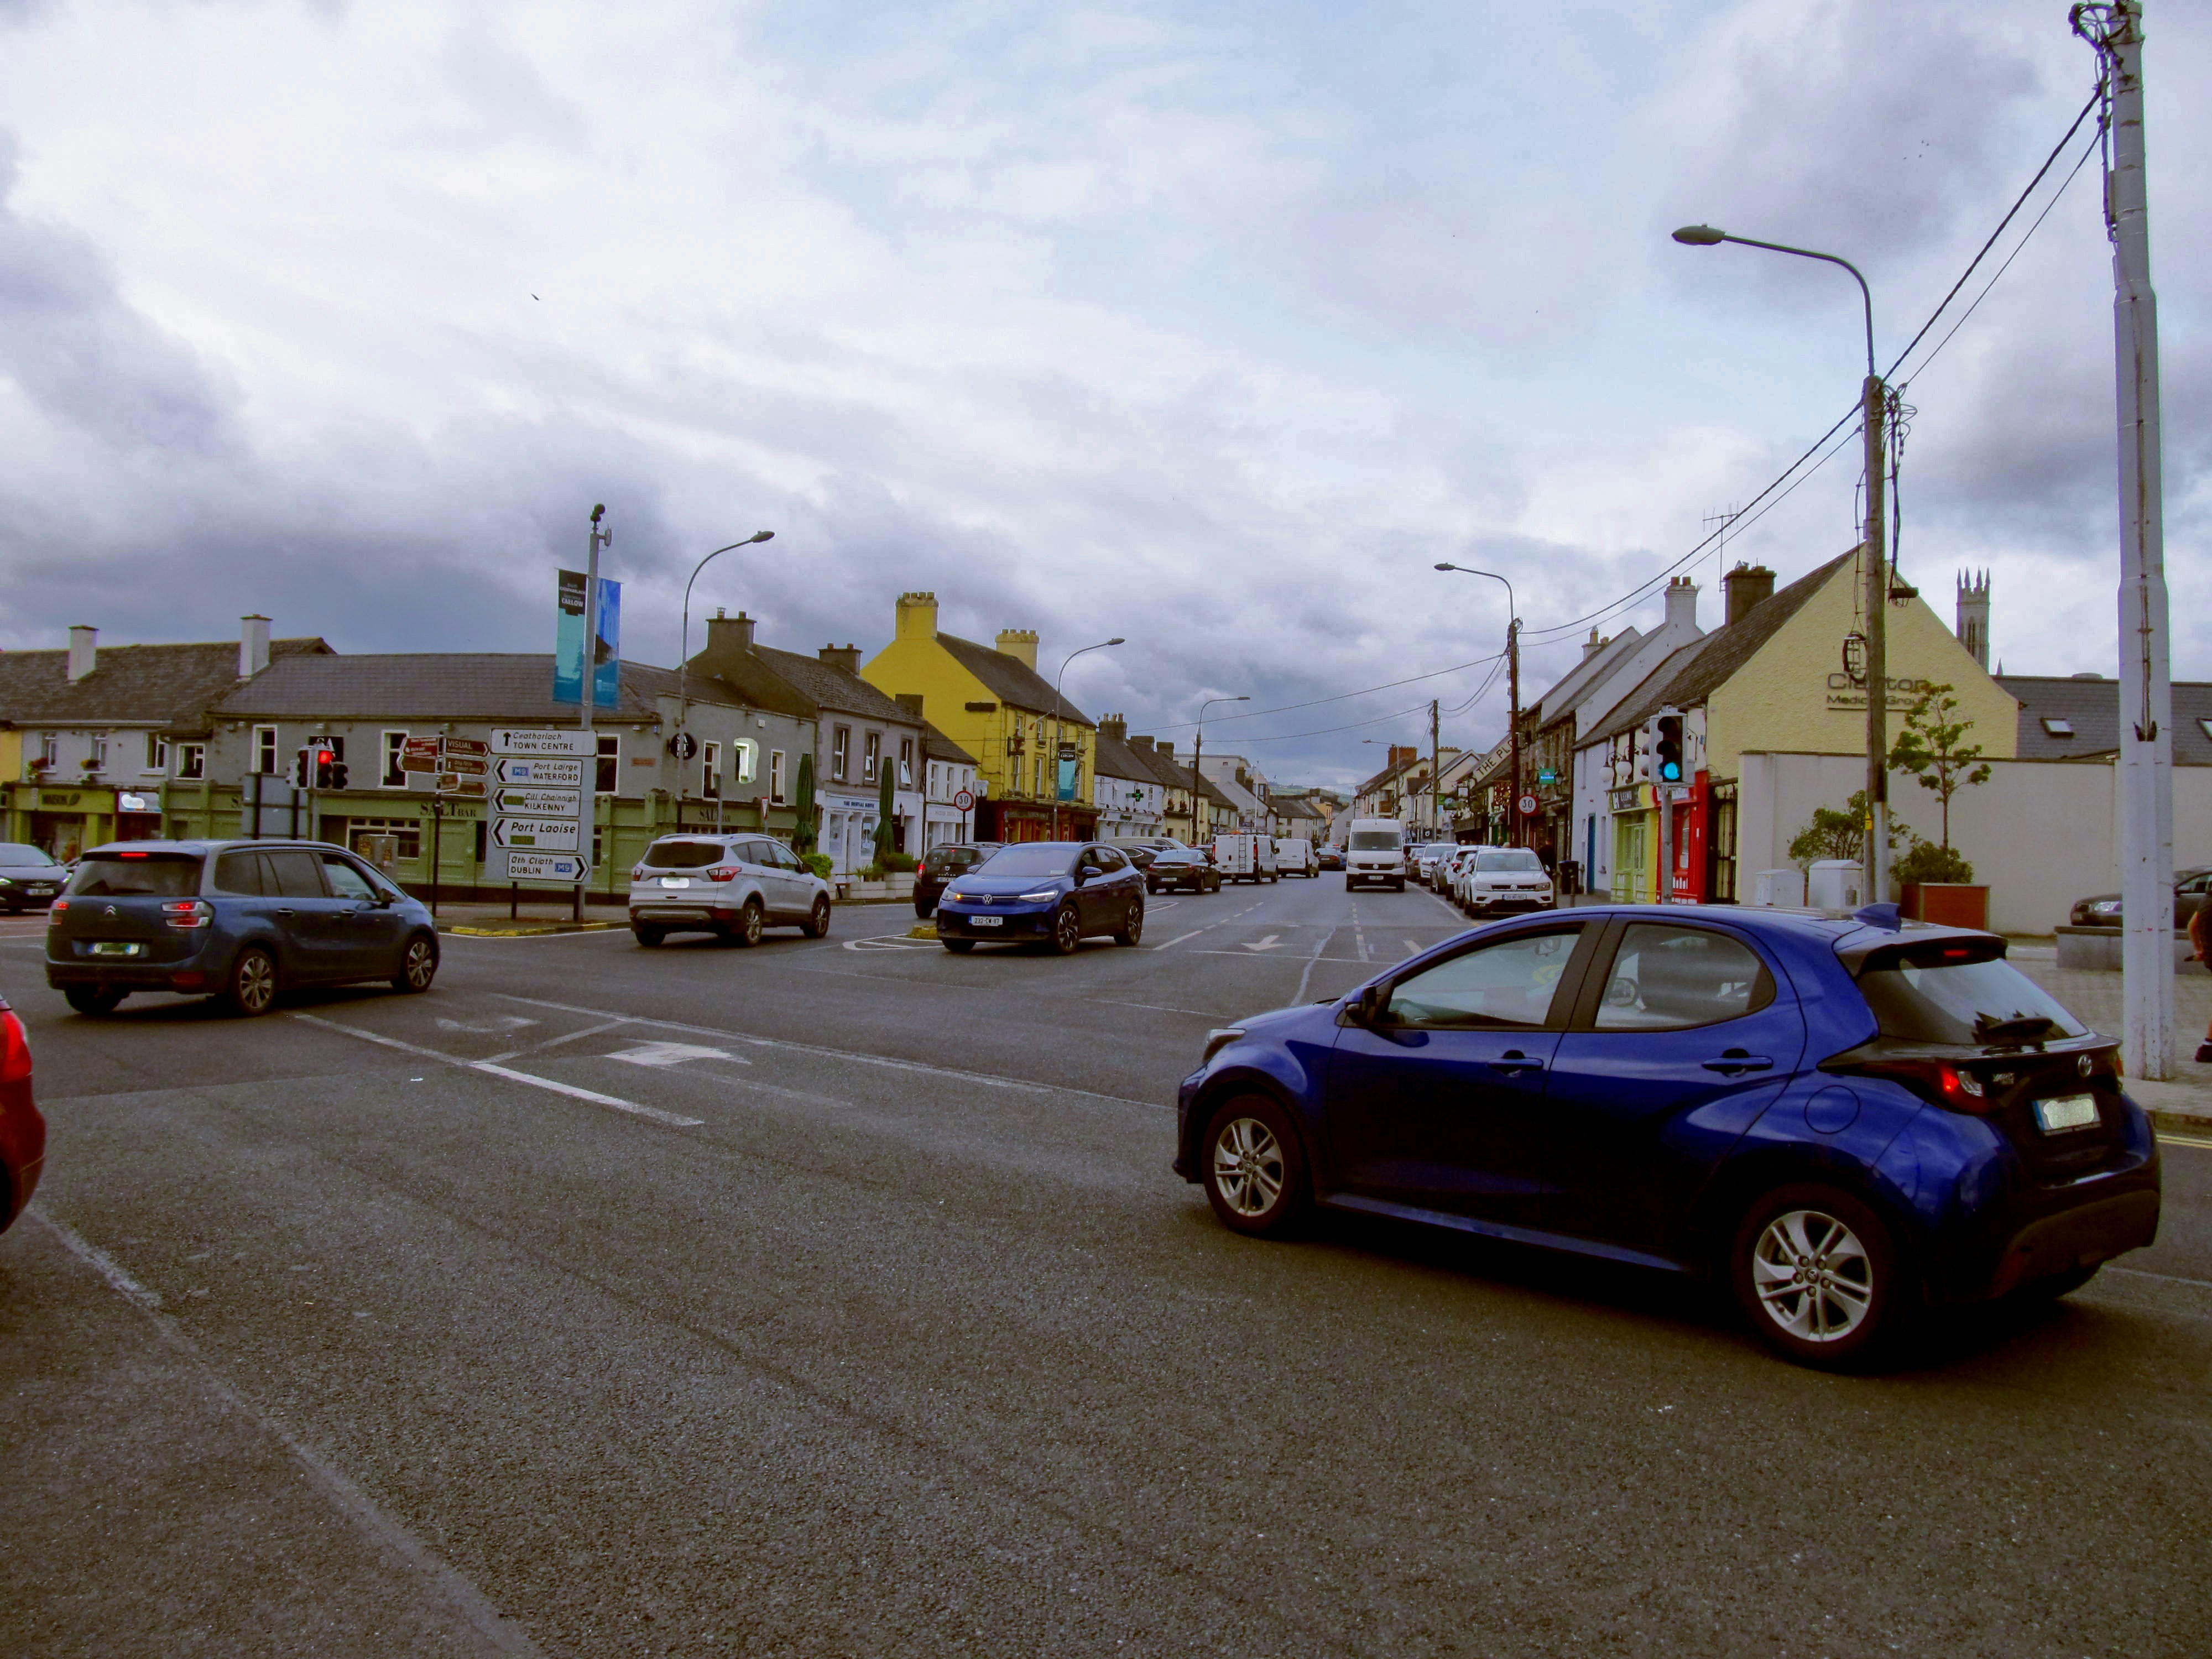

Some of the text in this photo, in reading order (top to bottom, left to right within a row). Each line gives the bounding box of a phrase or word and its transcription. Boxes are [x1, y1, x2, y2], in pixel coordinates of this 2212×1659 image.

[1828, 673, 1928, 691] Claton
[448, 739, 473, 749] VISUAL
[554, 763, 578, 771] Lairge
[1476, 757, 1496, 775] THE
[541, 793, 577, 802] Chainnigh
[958, 796, 968, 804] 30
[1522, 800, 1533, 808] 30
[458, 808, 476, 817] BAR
[511, 822, 576, 833] Port Laoise
[529, 857, 553, 865] Cliath
[511, 866, 541, 874] DUBLIN
